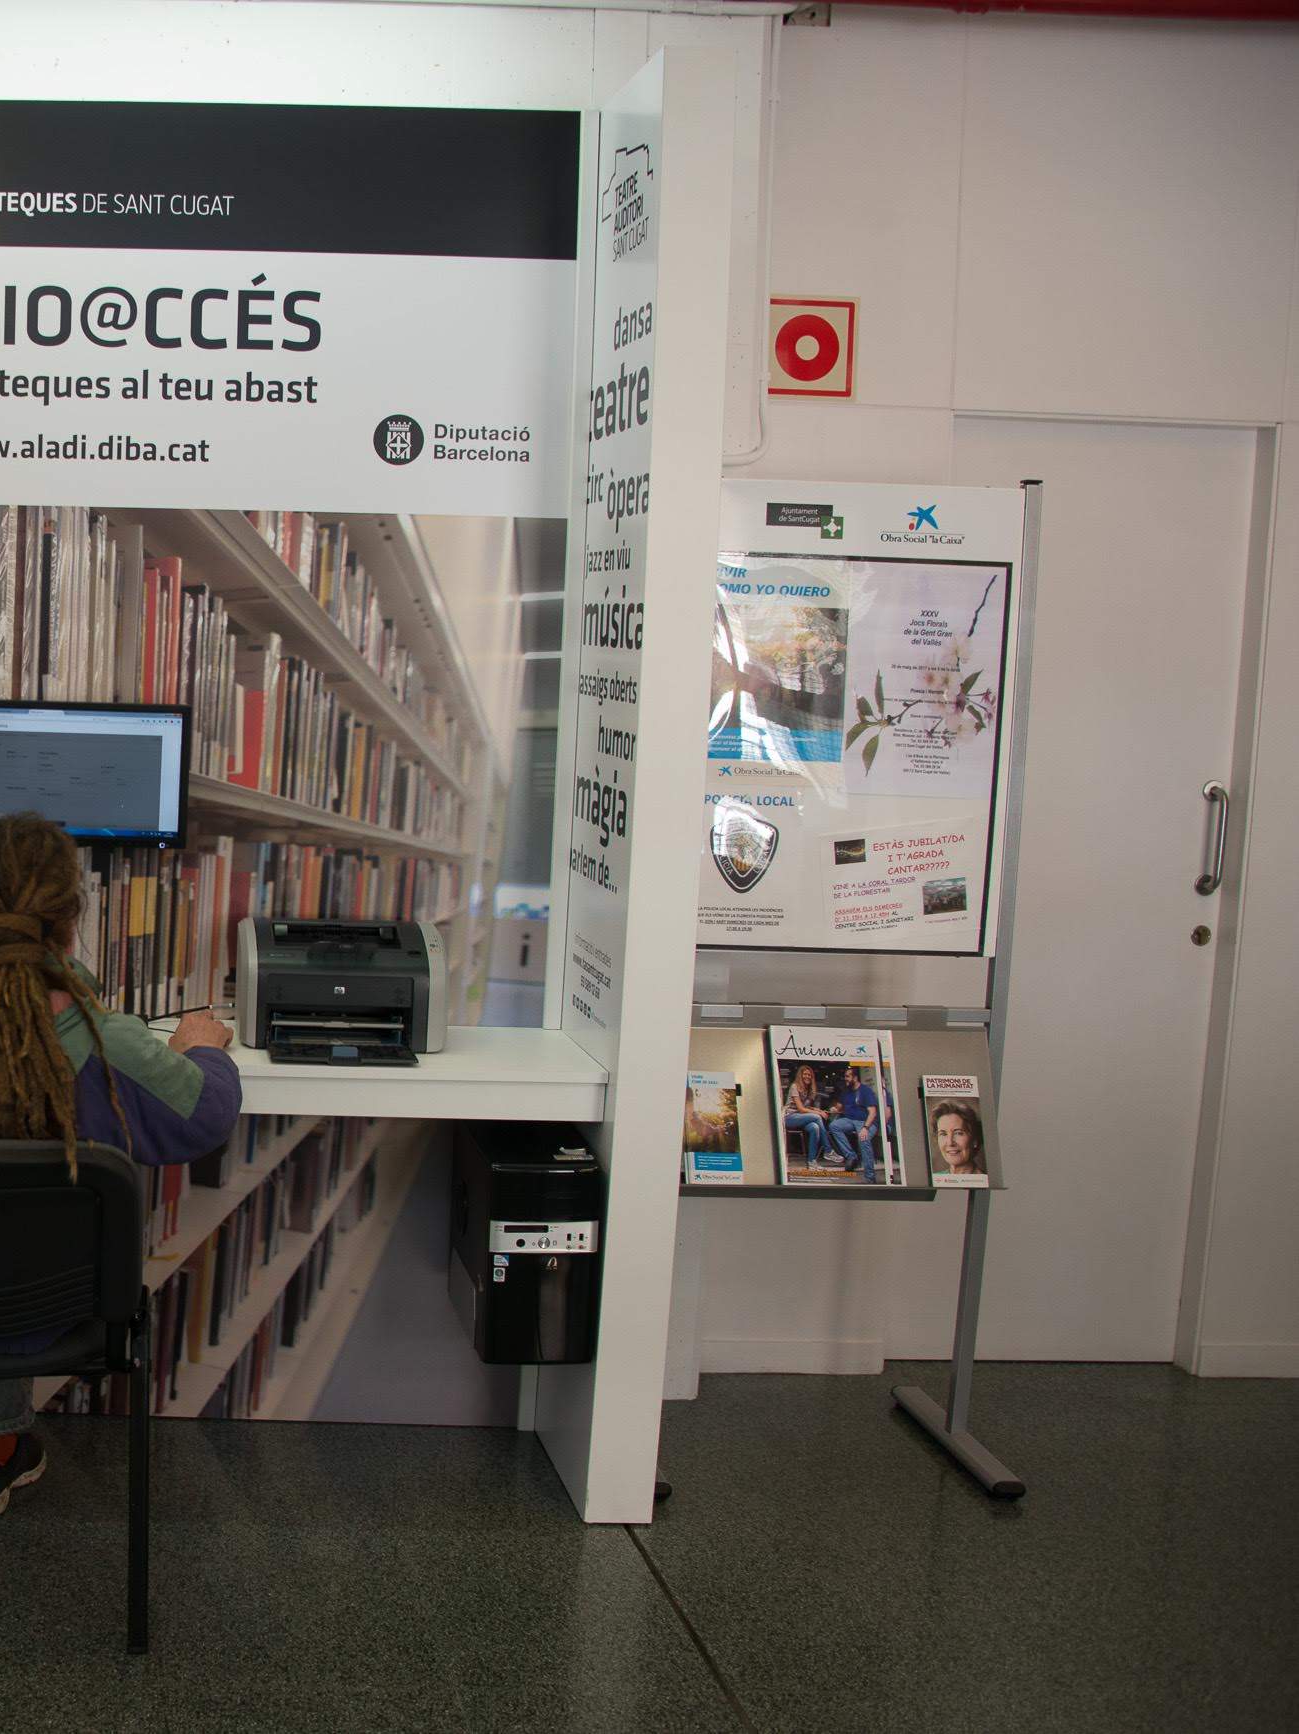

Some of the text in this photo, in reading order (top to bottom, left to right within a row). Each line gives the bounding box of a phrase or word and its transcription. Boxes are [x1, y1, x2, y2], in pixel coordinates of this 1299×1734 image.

[615, 171, 639, 208] TEATRE
[83, 193, 107, 213] DE
[113, 194, 165, 215] SANT
[170, 194, 235, 216] CUGAT
[613, 193, 644, 236] AUDITORI
[612, 216, 650, 262] SANT CUGAT
[613, 302, 653, 350] dansa
[121, 369, 150, 400] al
[159, 373, 213, 401] teu
[224, 372, 318, 404] abast
[434, 424, 530, 443] Diputació
[433, 445, 530, 462] Barcelona
[607, 467, 650, 534] òpera
[780, 506, 819, 516] Ajuntament
[880, 533, 902, 543] Obra
[903, 534, 928, 544] Social
[585, 540, 631, 578] jazz en viu
[719, 583, 752, 595] OMO
[756, 584, 775, 595] YO
[583, 585, 645, 650] música
[910, 619, 949, 629] Jocs Florals
[920, 609, 940, 618] XXXV
[920, 630, 937, 638] Gent
[936, 631, 953, 639] Gran
[579, 668, 638, 706] assaigs oberts
[597, 715, 637, 762] humor
[752, 768, 774, 776] Social
[574, 765, 628, 848] màgia
[756, 796, 796, 807] LOCAL
[872, 834, 966, 852] ESTÀS JUBILAT/DA
[887, 849, 945, 862] I T'AGRADA
[774, 1028, 848, 1058] Ànima
